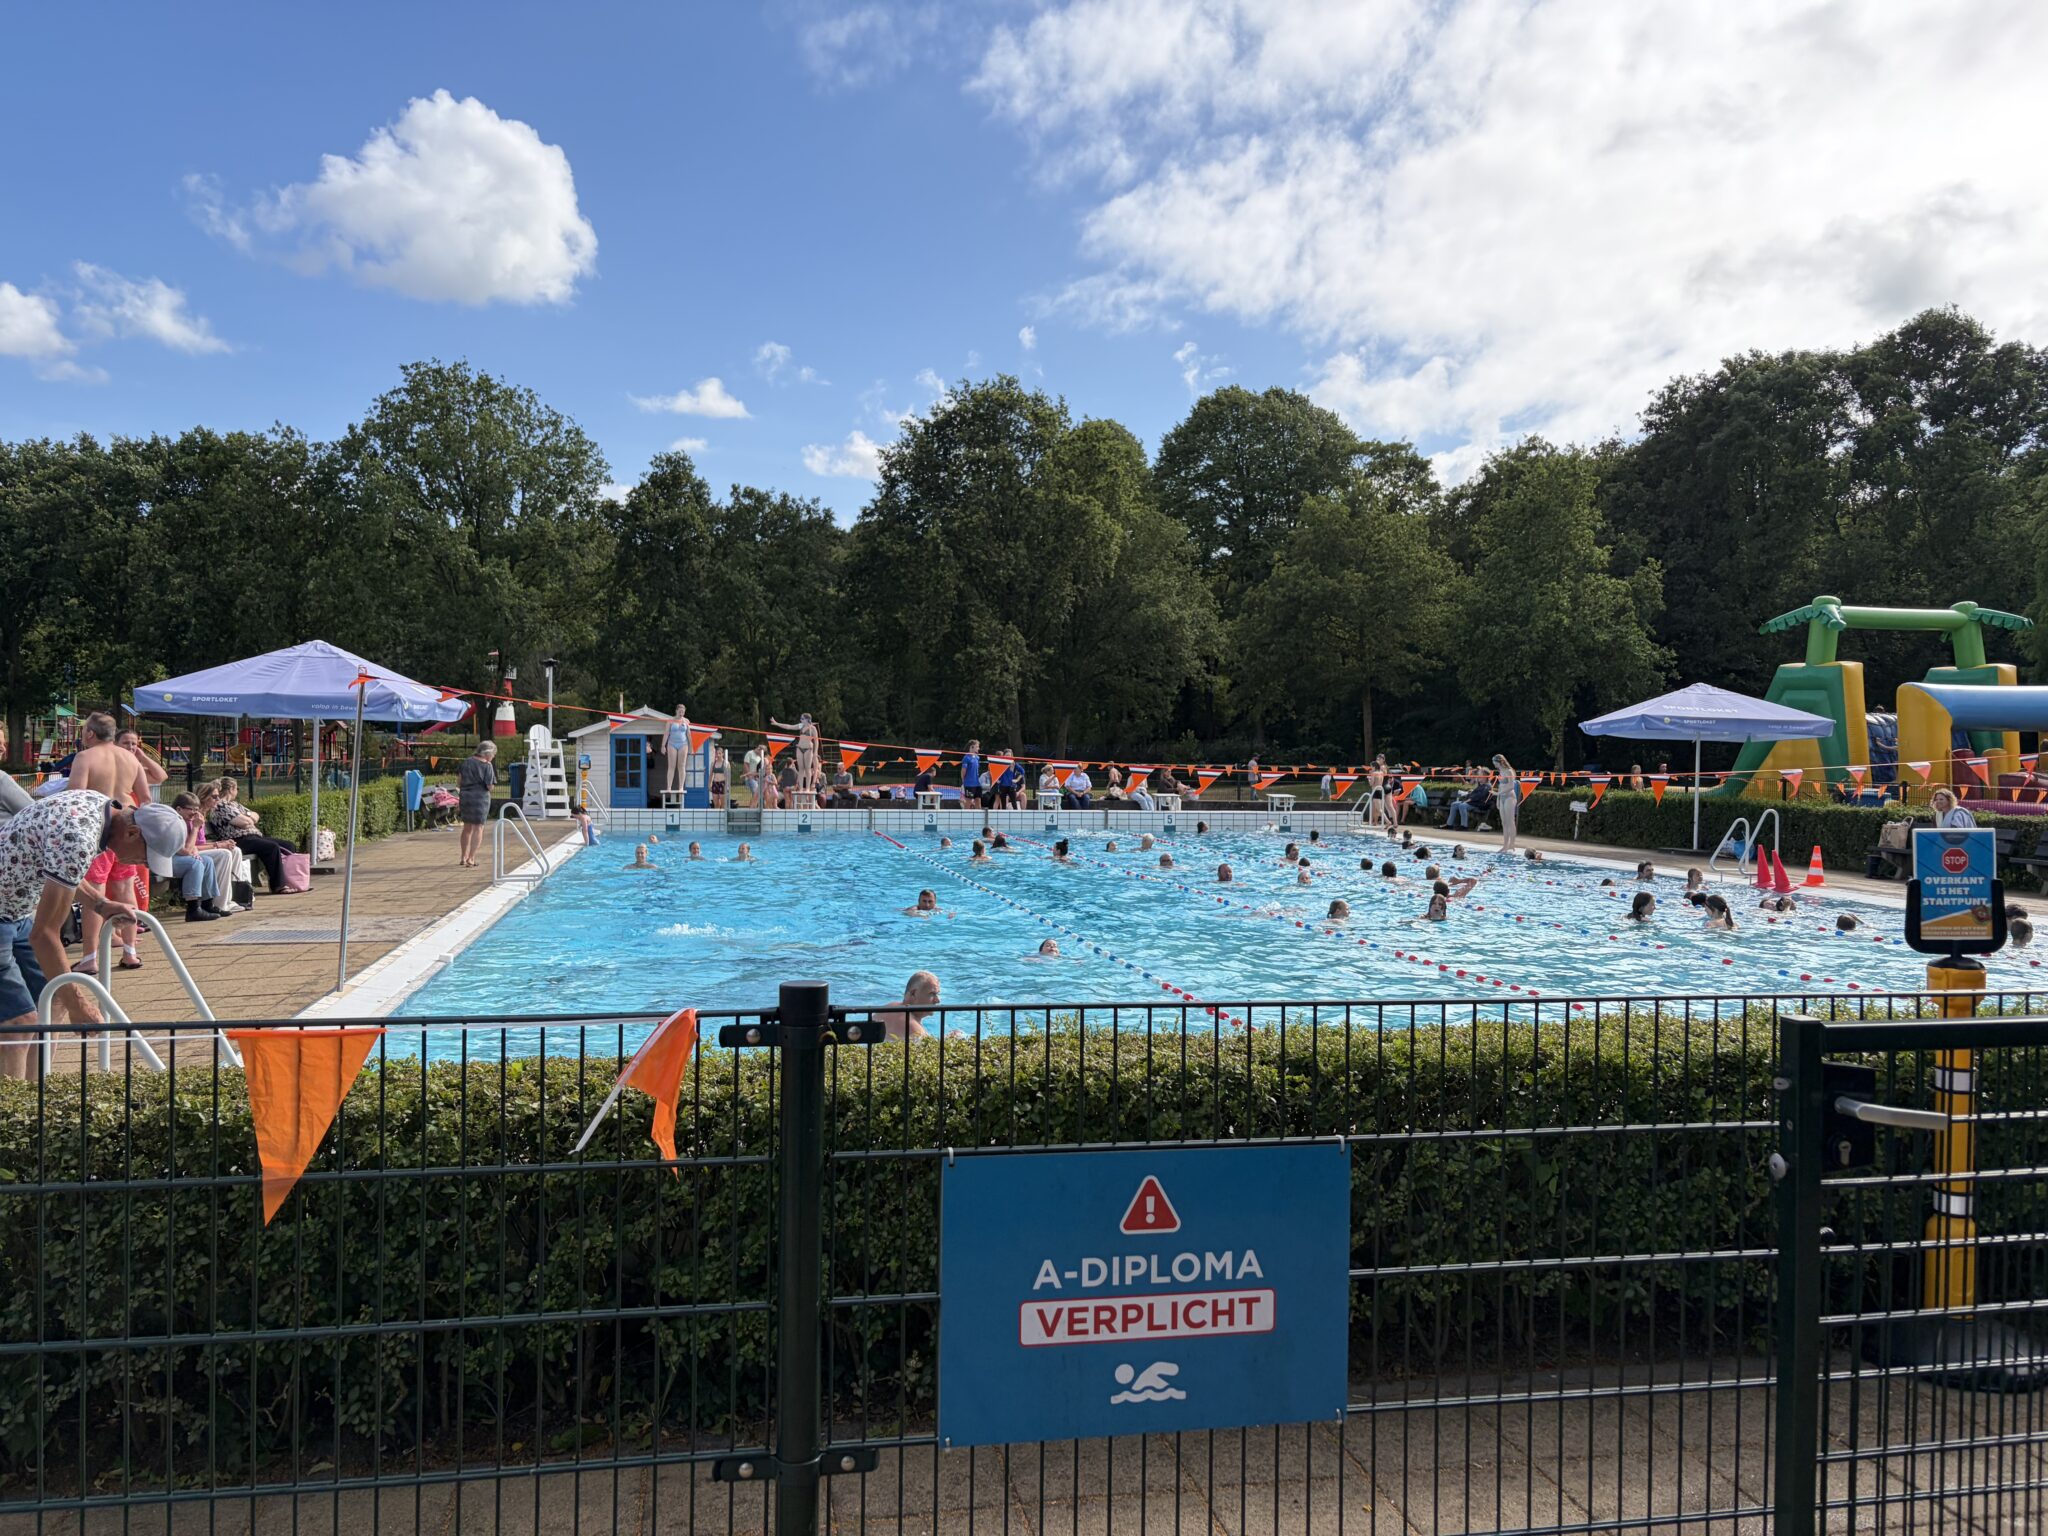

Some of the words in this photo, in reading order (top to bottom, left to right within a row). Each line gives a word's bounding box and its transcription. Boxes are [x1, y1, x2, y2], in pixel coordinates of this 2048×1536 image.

[801, 813, 808, 824] 2
[927, 813, 934, 824] 3
[1048, 814, 1055, 824] 4
[1167, 814, 1173, 825] 5
[1282, 815, 1288, 825] 6
[1944, 856, 1967, 865] STOP
[1924, 876, 1985, 885] OVERKANT
[1936, 887, 1947, 895] IS
[1948, 887, 1970, 895] HET
[1032, 1249, 1264, 1290] A-DIPLOMA
[1036, 1296, 1262, 1338] VERPLICHT
